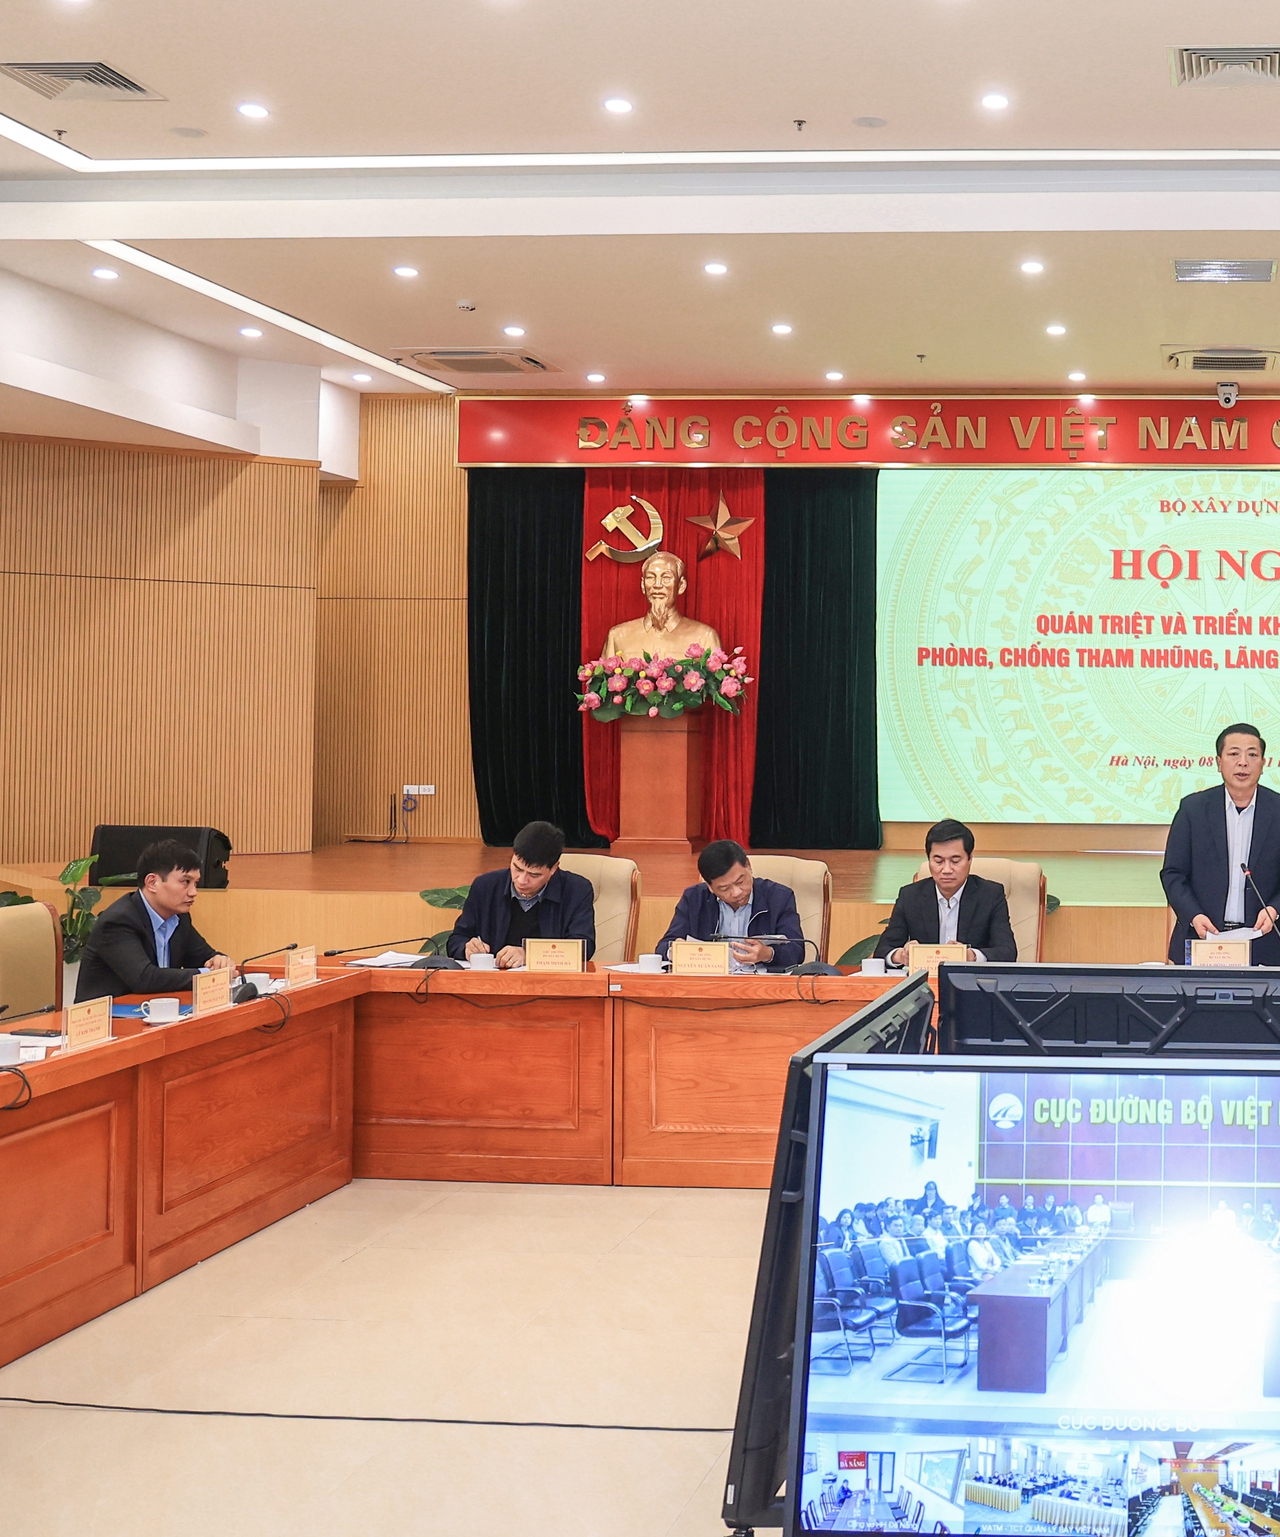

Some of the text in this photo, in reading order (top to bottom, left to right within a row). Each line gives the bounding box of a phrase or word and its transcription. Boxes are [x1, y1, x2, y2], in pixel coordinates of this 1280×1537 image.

[577, 402, 711, 450] ĐẢNG
[732, 406, 869, 458] CỘNG
[890, 402, 988, 450] SẢN
[1009, 407, 1118, 458] VIỆT
[1138, 416, 1249, 450] NAM
[1159, 499, 1187, 517] BỘ
[1190, 497, 1232, 513] XÂY
[1110, 543, 1201, 589] HỘI
[1036, 611, 1093, 636] QUÁN
[1099, 611, 1155, 639] TRIỆT
[1160, 611, 1187, 635] VÀ
[1193, 608, 1253, 635] TRIỂN
[917, 643, 994, 669] PHÒNG,
[999, 641, 1071, 668] CHỐNG
[1076, 648, 1135, 668] THAM
[1140, 645, 1219, 670] NHŨNG,
[1225, 646, 1279, 669] LÃNG
[1109, 756, 1213, 769] Hà Nội, ngày 08
[1033, 1098, 1082, 1128] CỤC
[1089, 1094, 1173, 1125] ĐƯỜNG
[1180, 1095, 1214, 1129] BỘ
[1220, 1095, 1273, 1130] VIỆT
[1057, 1415, 1097, 1430] CUC
[1102, 1415, 1170, 1432] DUONG
